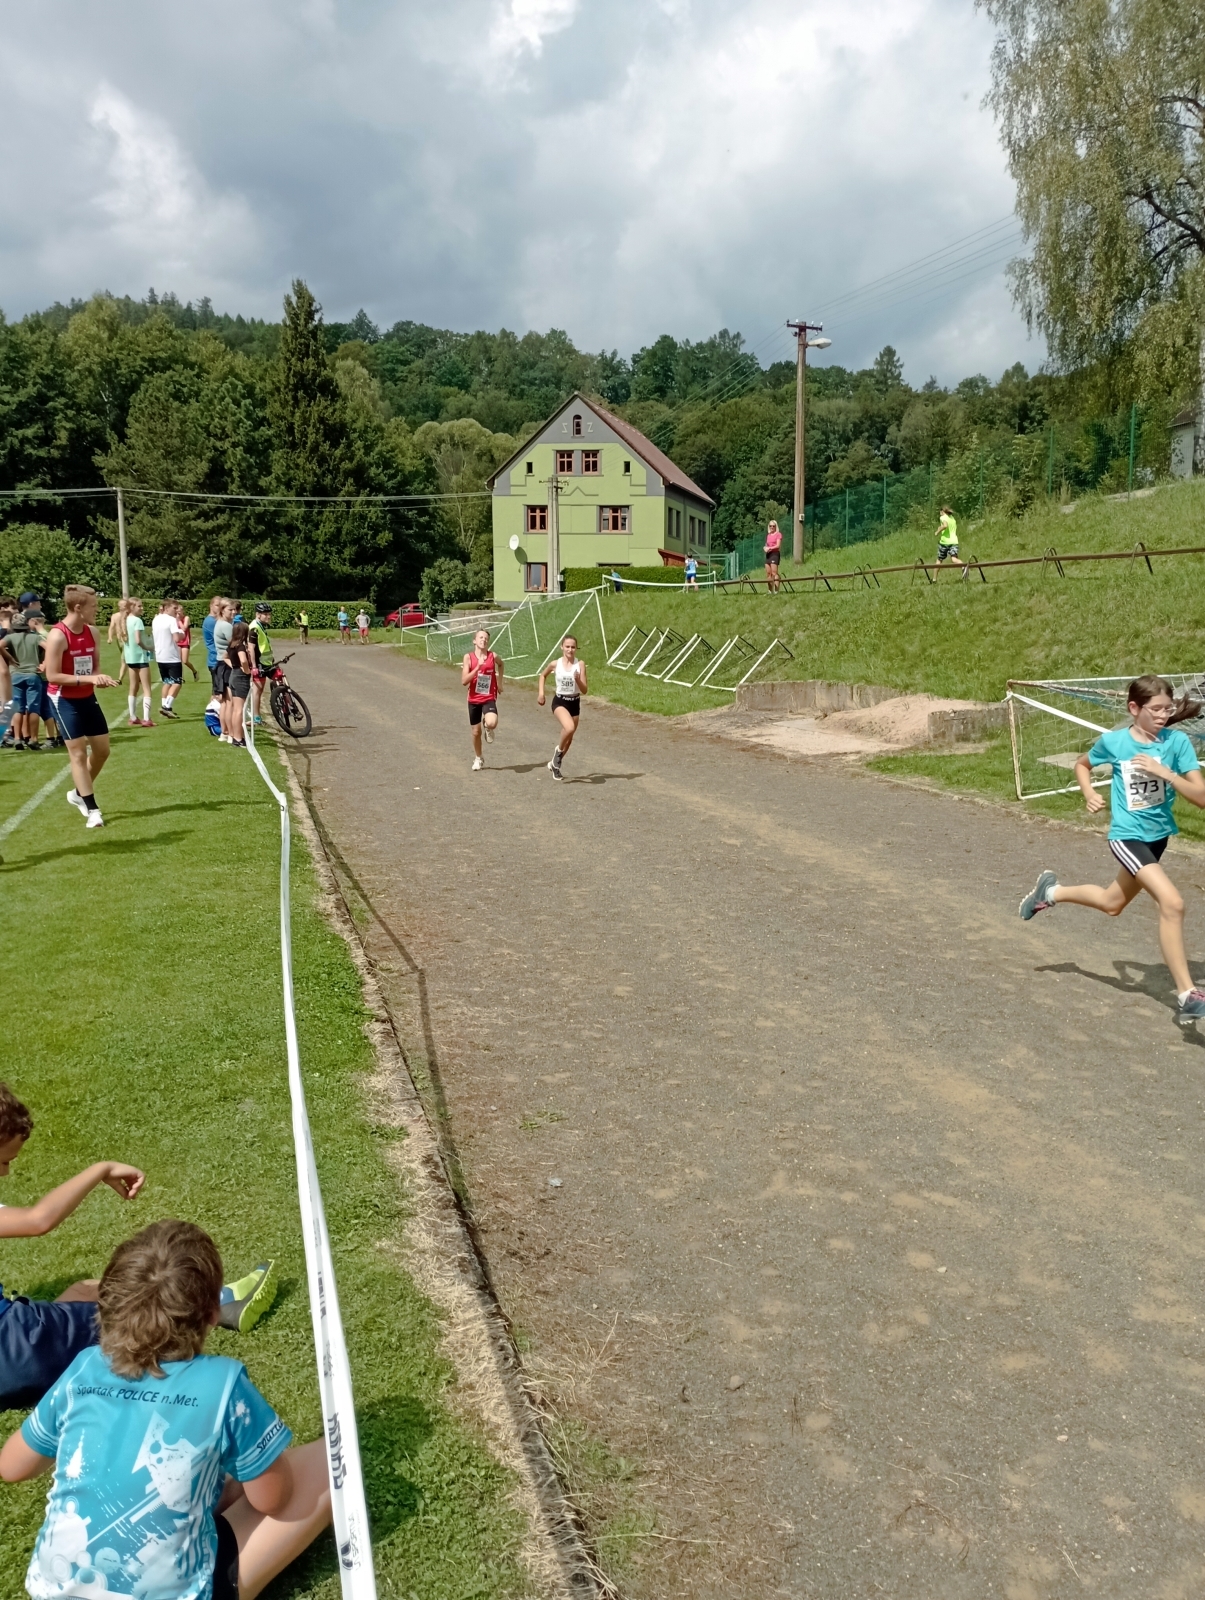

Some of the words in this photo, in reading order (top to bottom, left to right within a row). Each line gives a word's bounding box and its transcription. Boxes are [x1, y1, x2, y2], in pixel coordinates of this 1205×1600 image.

[1130, 780, 1159, 795] 573
[77, 1384, 114, 1397] Spartak
[116, 1388, 160, 1403] POLICE
[161, 1394, 199, 1407] n.Met.
